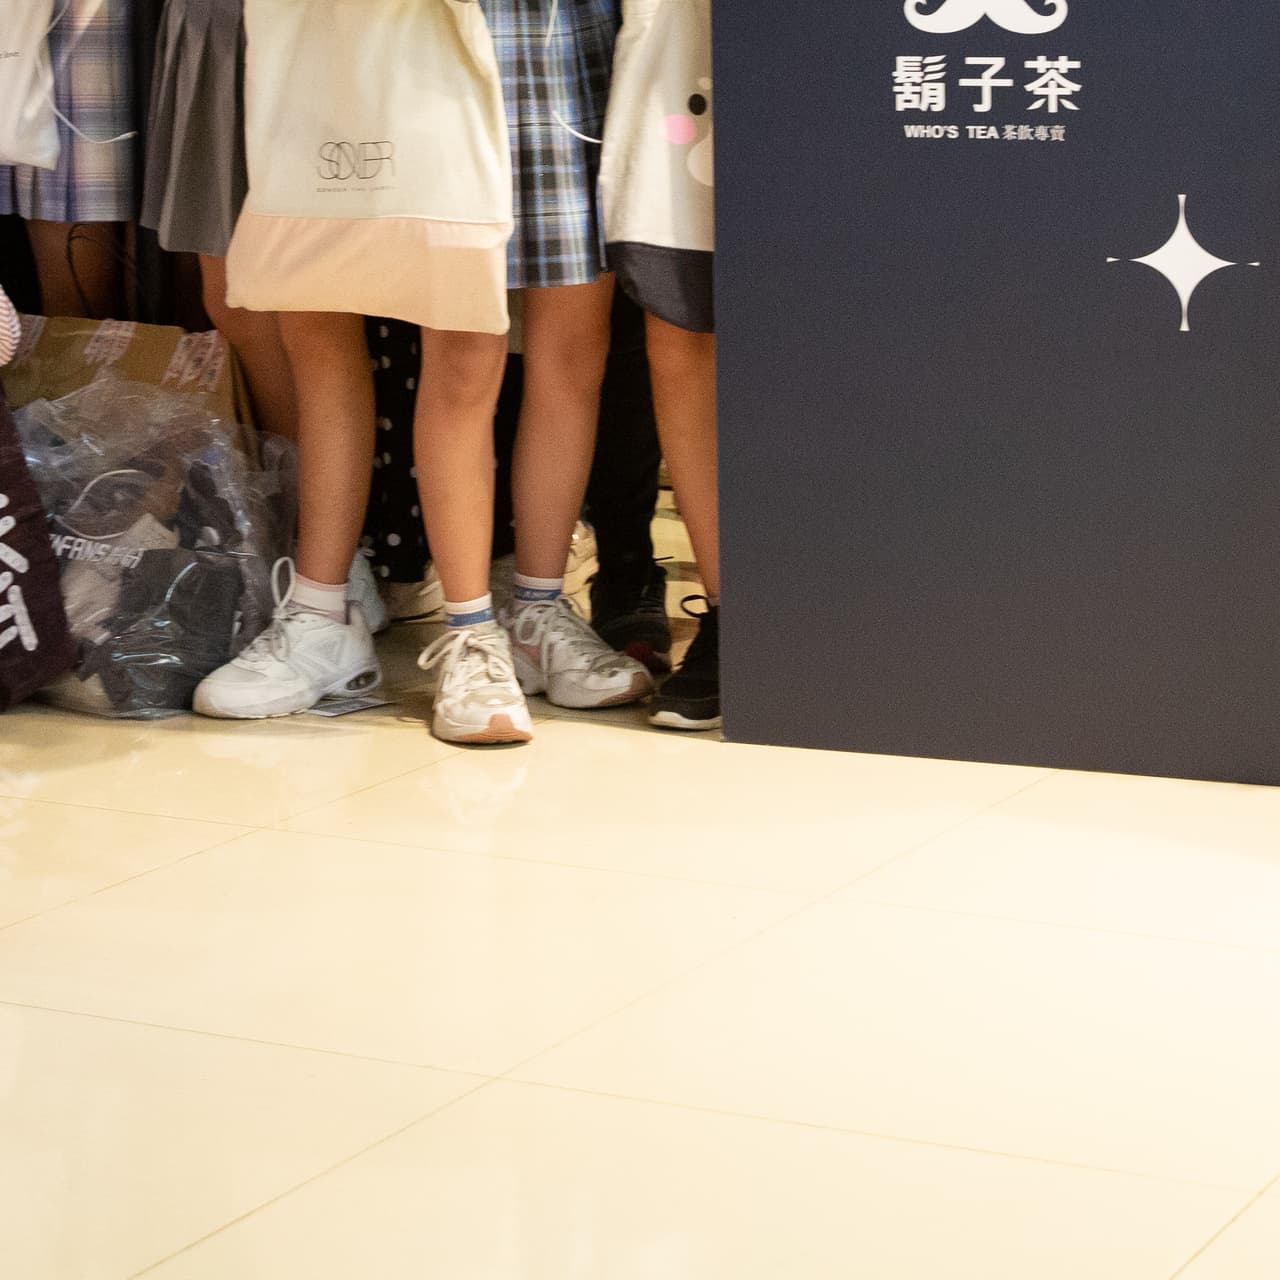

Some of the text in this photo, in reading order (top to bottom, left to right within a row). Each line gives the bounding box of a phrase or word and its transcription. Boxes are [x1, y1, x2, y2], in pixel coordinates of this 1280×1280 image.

[892, 54, 1083, 114] 鬍子茶
[904, 123, 1067, 143] WHO'S TEA 茶飲專賣
